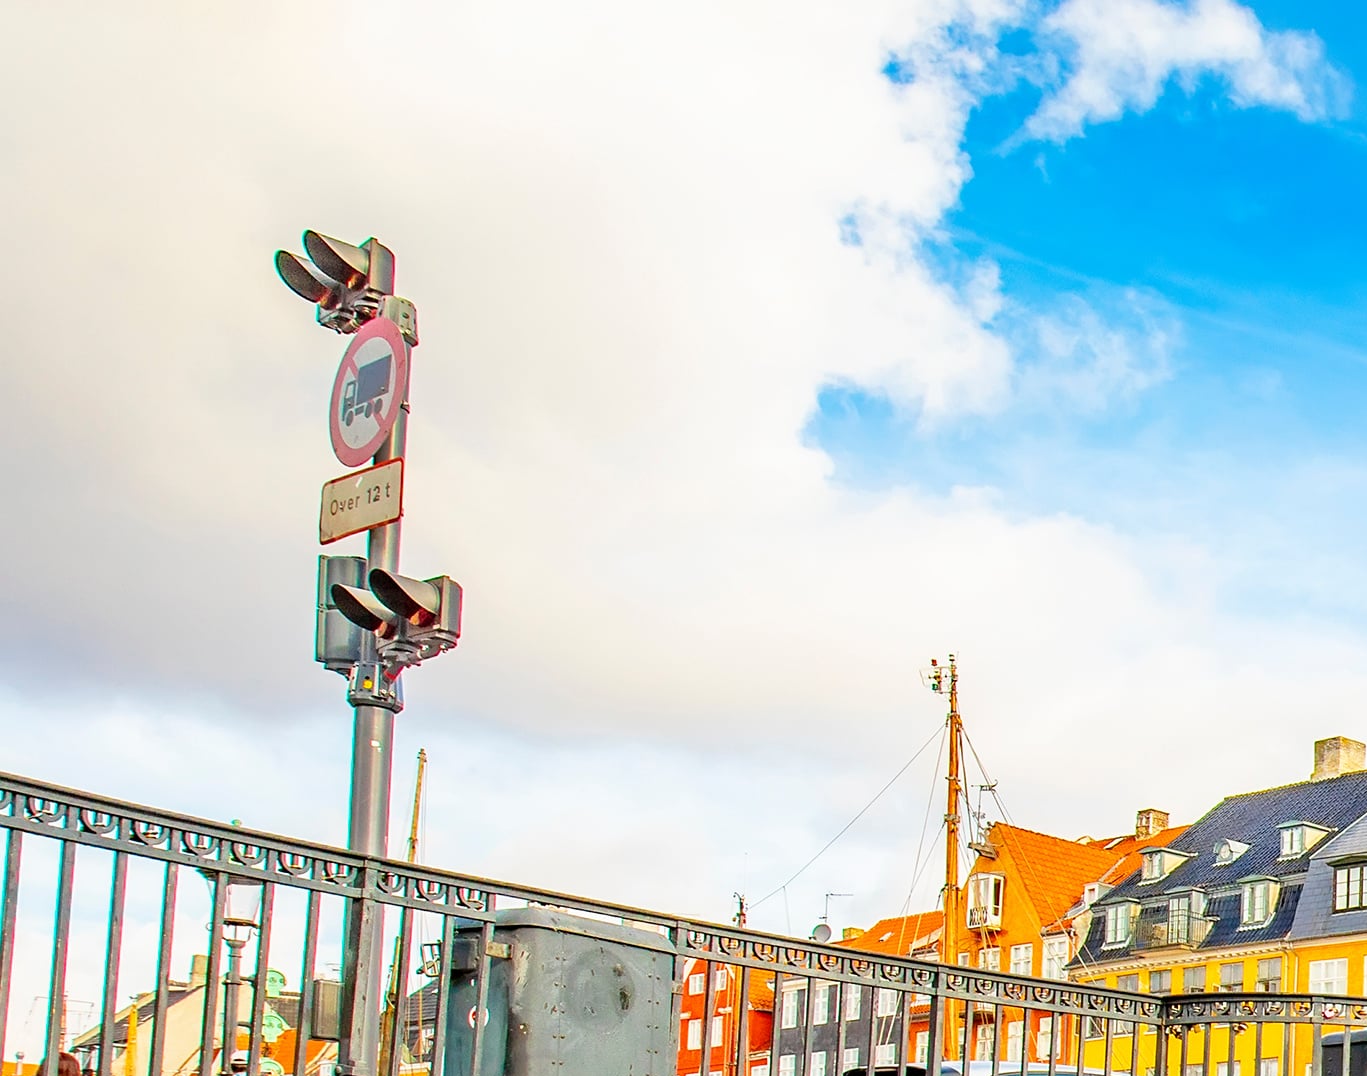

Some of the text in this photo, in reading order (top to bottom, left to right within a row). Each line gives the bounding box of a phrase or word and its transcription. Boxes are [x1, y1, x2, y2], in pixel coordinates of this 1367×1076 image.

[330, 482, 391, 516] Over 12 t
